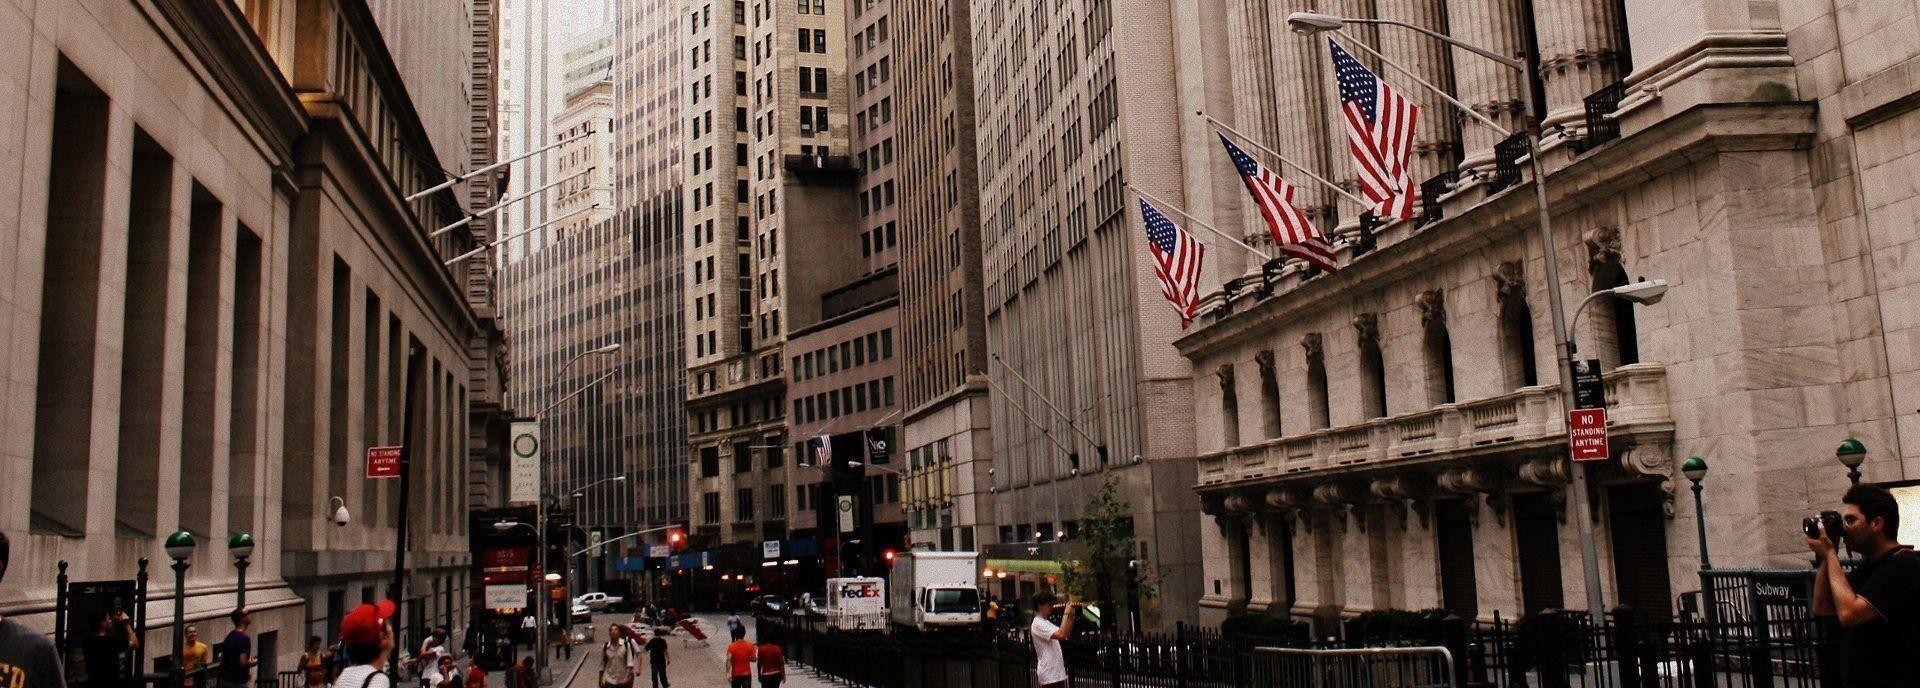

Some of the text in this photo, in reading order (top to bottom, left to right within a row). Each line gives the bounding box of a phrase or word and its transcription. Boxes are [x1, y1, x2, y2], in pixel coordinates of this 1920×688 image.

[1581, 415, 1594, 425] NO
[1572, 427, 1605, 437] STANDING
[1575, 438, 1604, 447] ANYTIME
[842, 584, 880, 598] FedEx
[1755, 582, 1789, 599] Subway
